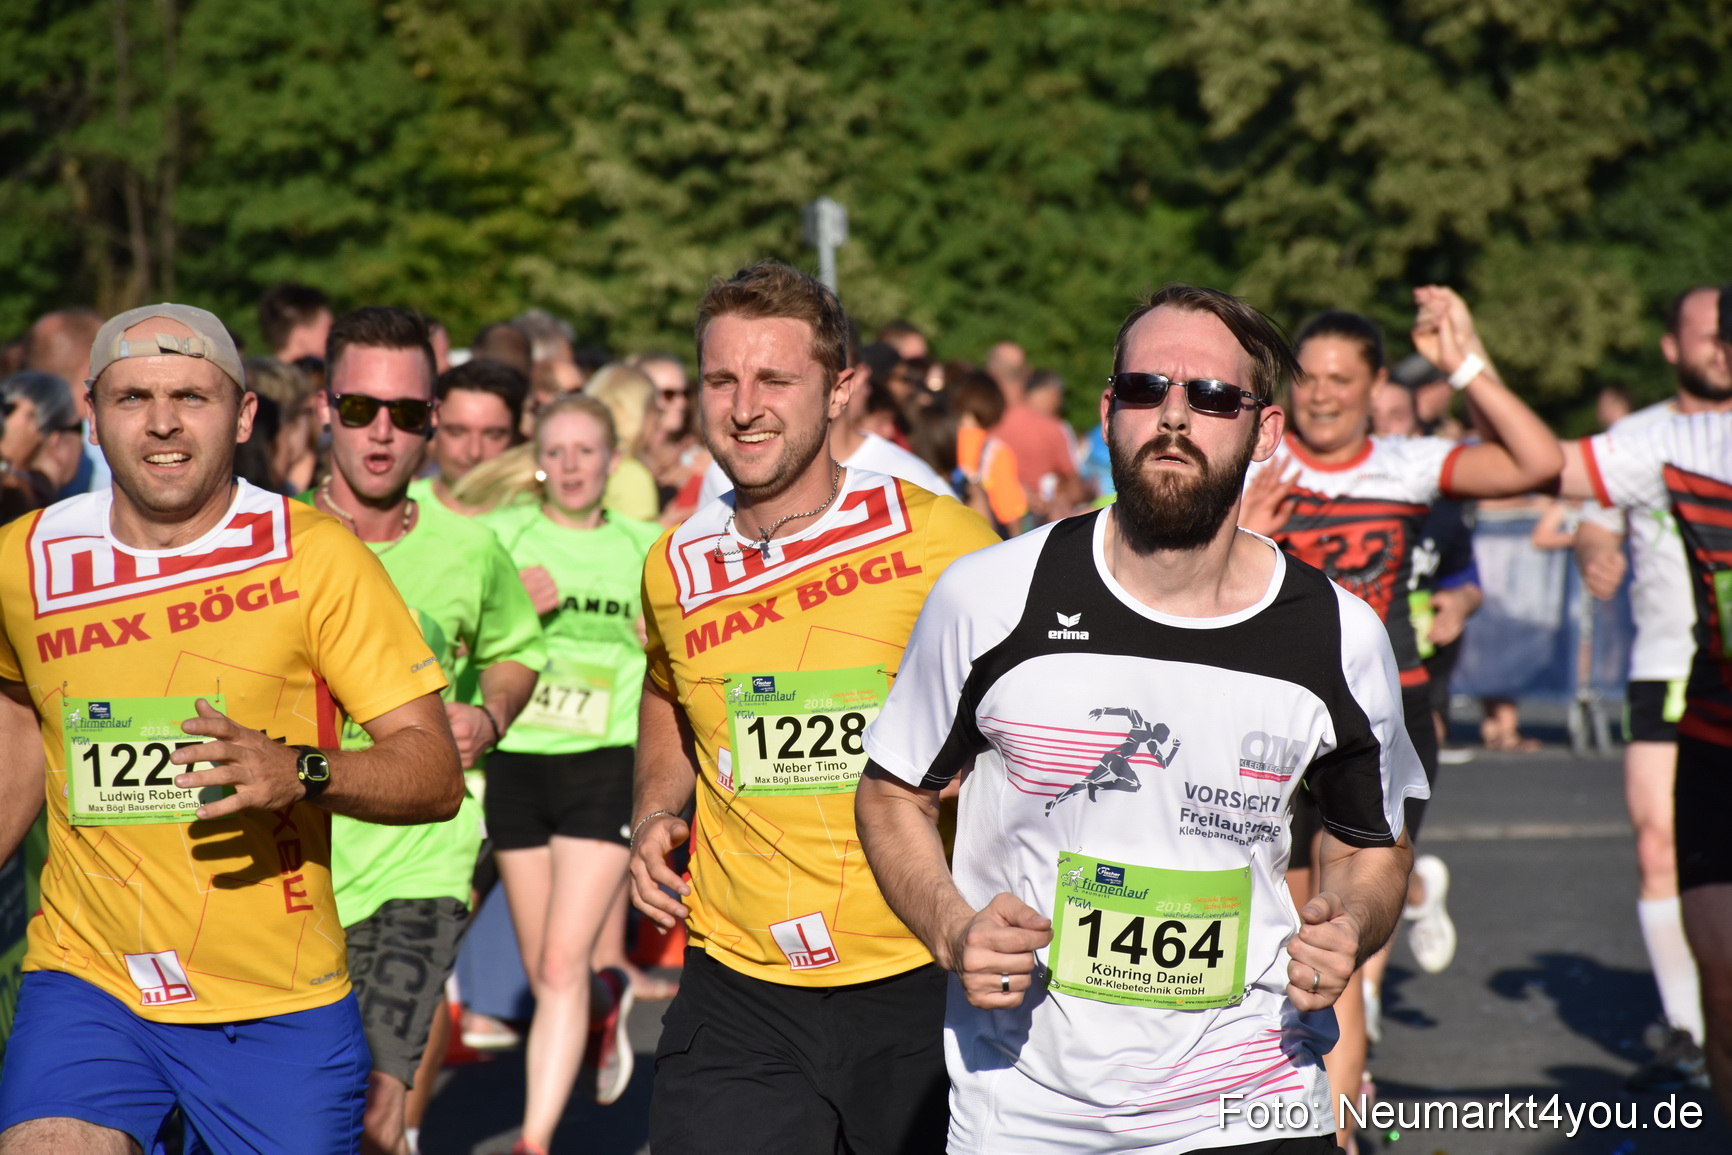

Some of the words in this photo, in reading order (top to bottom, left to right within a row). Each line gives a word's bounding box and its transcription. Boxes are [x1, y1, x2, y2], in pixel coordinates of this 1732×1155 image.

[684, 596, 785, 659] MAX
[796, 550, 923, 612] BÖGL
[36, 612, 152, 663] MAX
[167, 576, 300, 634] BÖGL
[1048, 628, 1090, 640] erima
[744, 690, 797, 701] firmenlauf
[804, 698, 833, 709] 2018
[80, 717, 133, 728] firmenlauf
[140, 726, 170, 737] 2018
[747, 712, 866, 760] 1228
[772, 762, 812, 773] Weber
[815, 761, 848, 771] Timo
[755, 776, 770, 784] Max
[773, 775, 791, 785] Bögl
[794, 774, 840, 783] Bauservice
[842, 771, 863, 780] Gmb
[100, 790, 145, 804] Ludwig
[150, 789, 193, 800] Robert
[1184, 781, 1281, 813] VORSICHT
[88, 804, 104, 812] Max
[106, 803, 126, 813] Bögl
[128, 803, 176, 812] Bauservice
[1180, 807, 1281, 837] Freilauende
[1082, 878, 1150, 900] firmenlauf
[1155, 901, 1192, 913] 2018
[1078, 909, 1224, 969] 1464
[1091, 962, 1152, 984] Köhring
[1157, 971, 1203, 984] Daniel
[1085, 976, 1171, 995] OM-Klebetechnik
[1174, 986, 1206, 995] GmbH
